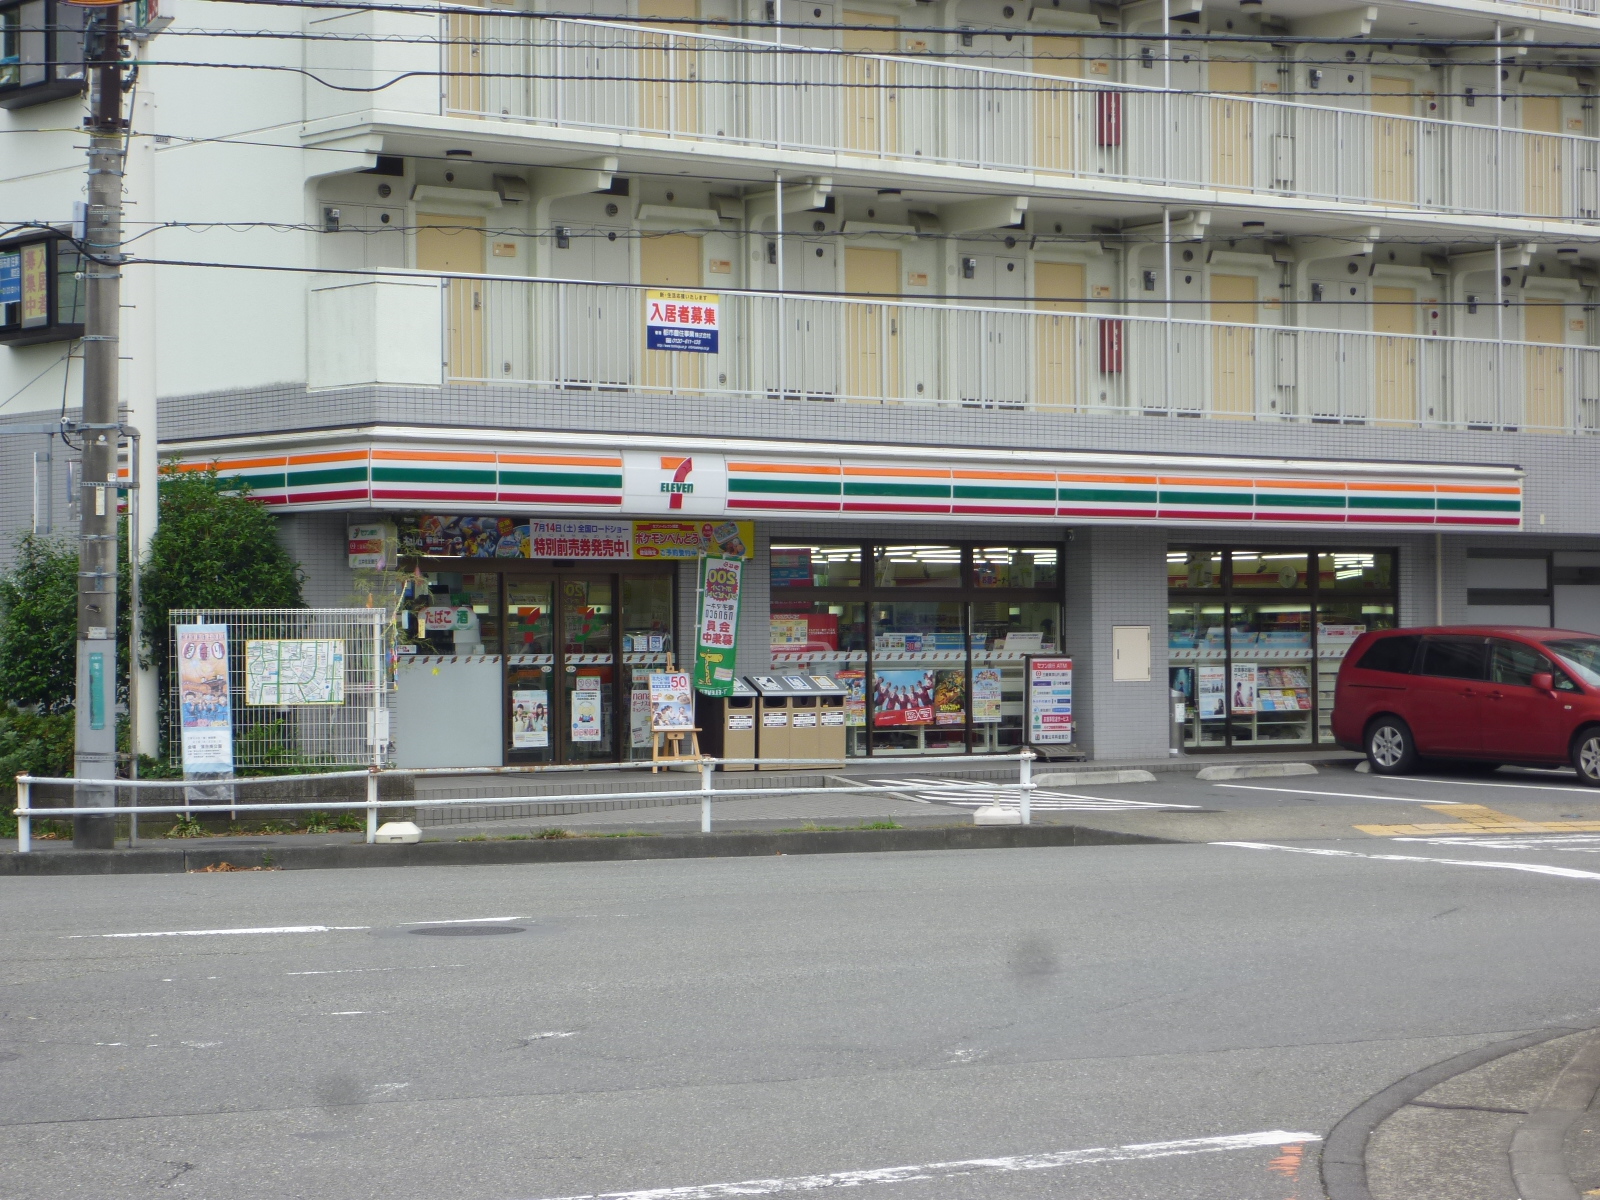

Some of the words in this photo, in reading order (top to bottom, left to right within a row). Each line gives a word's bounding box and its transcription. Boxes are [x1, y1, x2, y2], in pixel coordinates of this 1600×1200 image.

[650, 302, 716, 326] 入居者募集
[533, 538, 630, 557] 特別前売券発売中!
[425, 609, 452, 624] たばこ
[456, 610, 469, 624] 酒
[670, 675, 688, 688] 50
